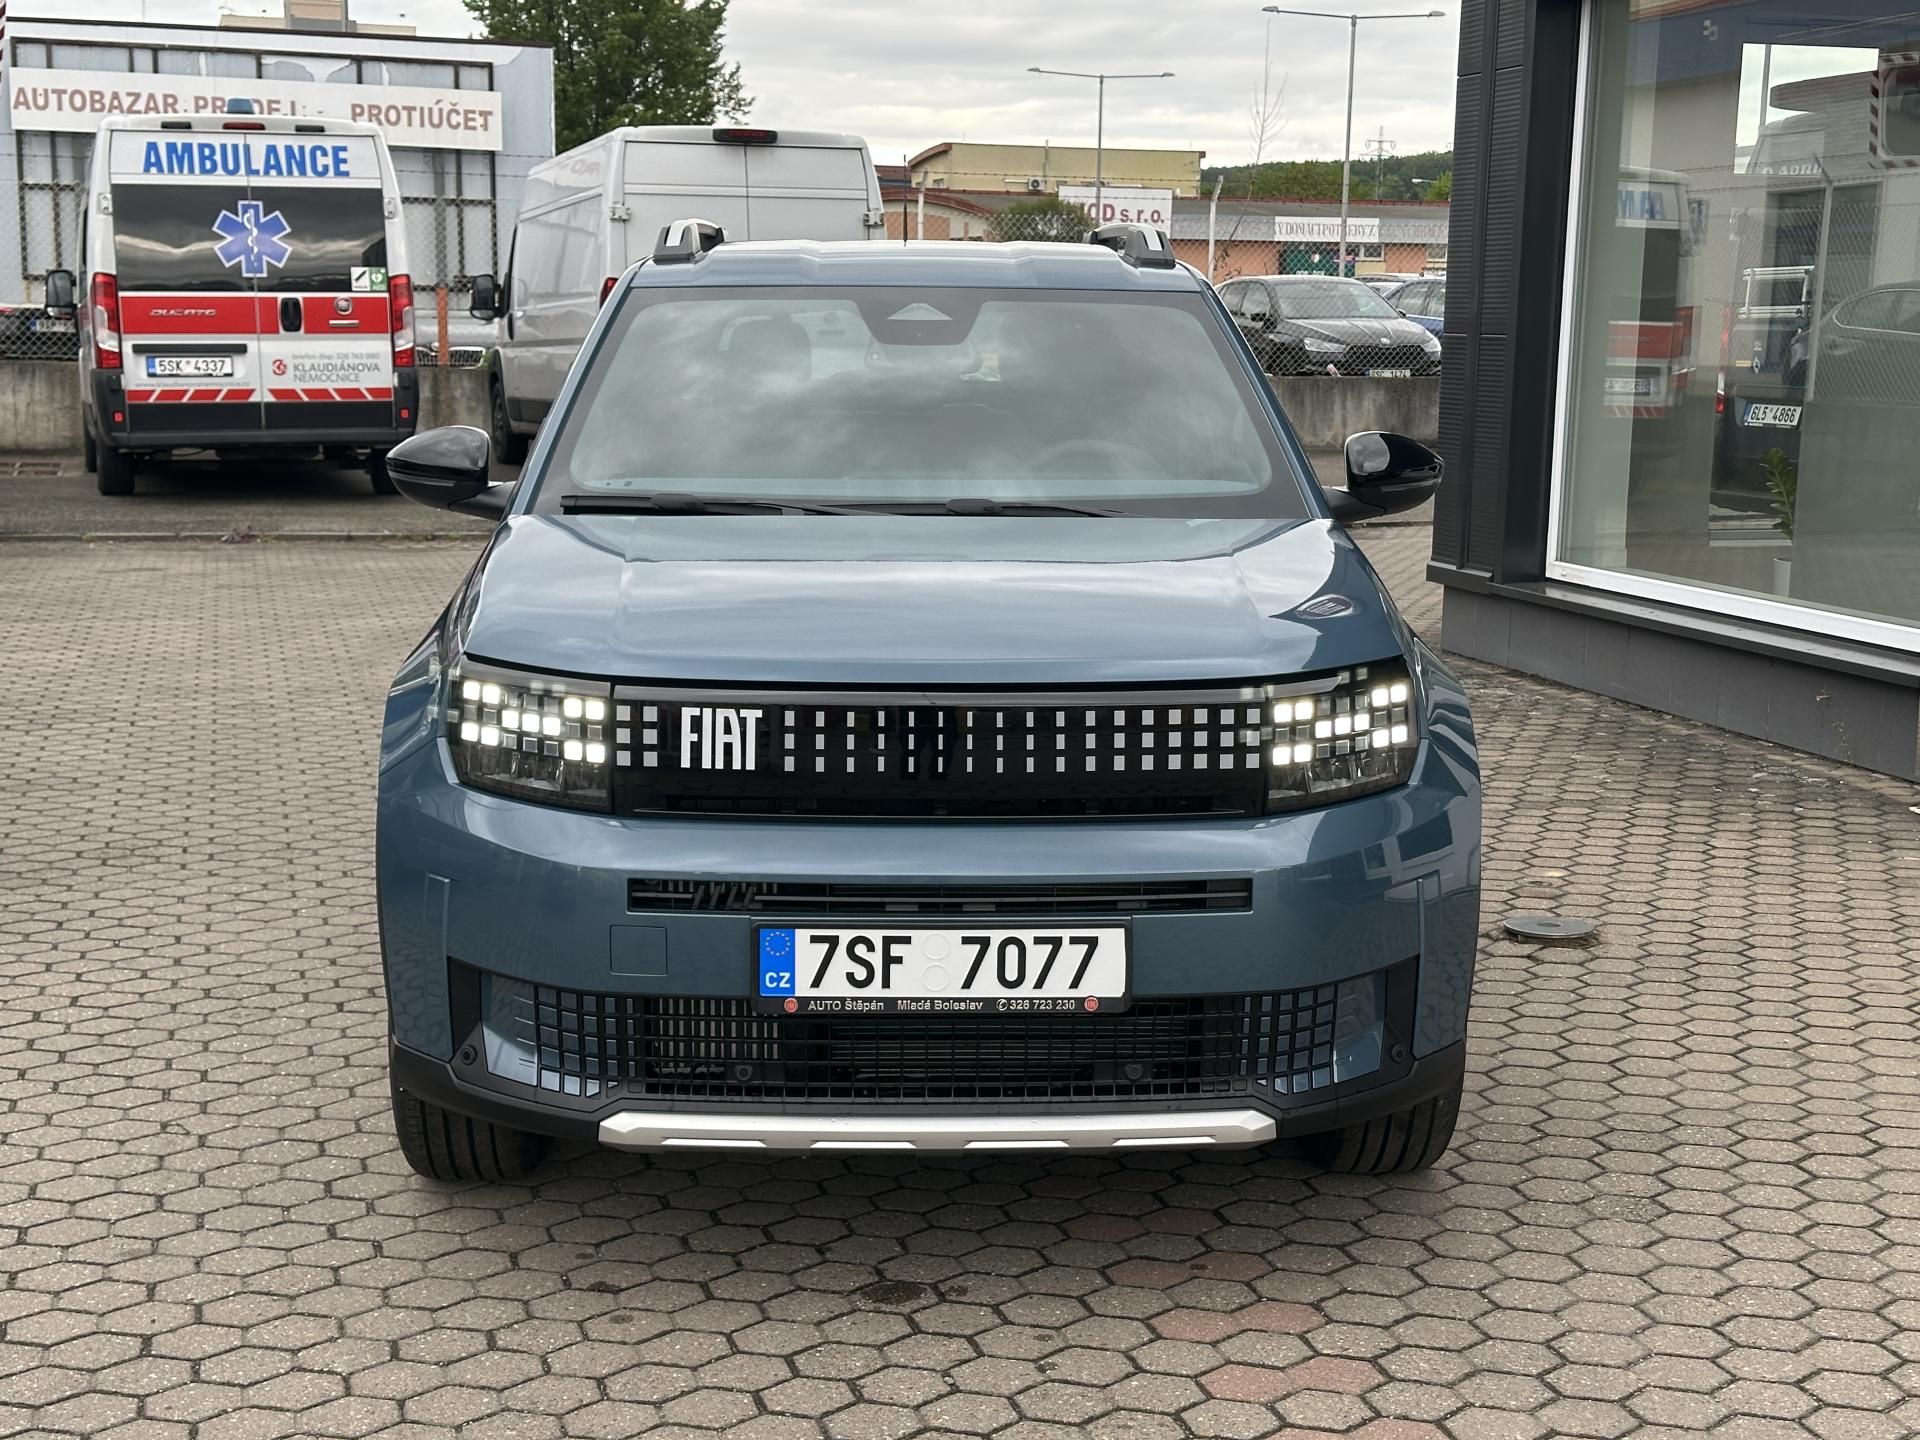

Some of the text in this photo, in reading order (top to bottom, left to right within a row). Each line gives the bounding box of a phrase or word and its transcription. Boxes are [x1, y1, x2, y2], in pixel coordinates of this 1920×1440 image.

[13, 87, 494, 132] AUTOBAZAR PRDEJ PROTIÚČET
[143, 141, 350, 177] AMBULANCE
[1120, 208, 1165, 223] s.r.o.
[158, 359, 225, 373] 5SK 4337
[293, 360, 380, 373] KLAUDIÁNOVA
[293, 372, 360, 383] NEMOCNICE
[1772, 407, 1796, 423] 4866
[680, 706, 763, 771] FIAT
[809, 934, 1099, 990] 7SF 7077
[765, 972, 791, 988] CZ
[807, 1000, 842, 1011] AUTO
[845, 998, 884, 1012] Štěpán
[897, 999, 931, 1011] Mladá
[934, 1000, 983, 1010] Boleslav
[1009, 1000, 1029, 1010] 326
[1033, 1000, 1053, 1010] 723
[1056, 1000, 1075, 1010] 230
